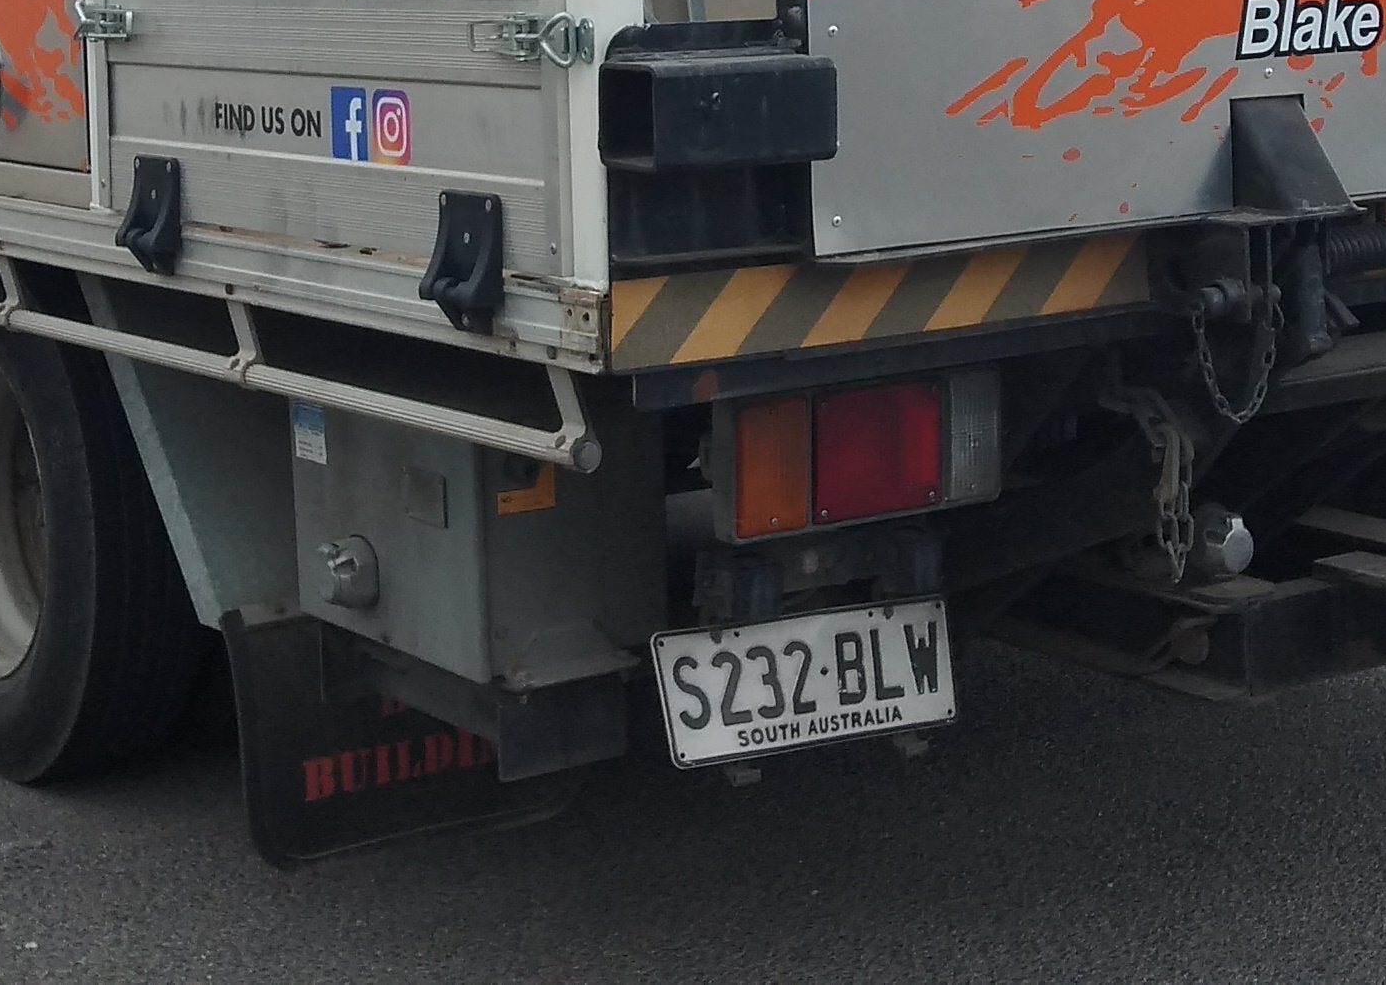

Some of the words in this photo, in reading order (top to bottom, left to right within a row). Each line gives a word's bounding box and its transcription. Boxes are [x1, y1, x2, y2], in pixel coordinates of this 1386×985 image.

[215, 102, 256, 132] FIND
[261, 105, 285, 135] US
[290, 108, 322, 138] ON
[737, 722, 801, 747] SOUTH
[807, 705, 903, 736] AUSTRALIA
